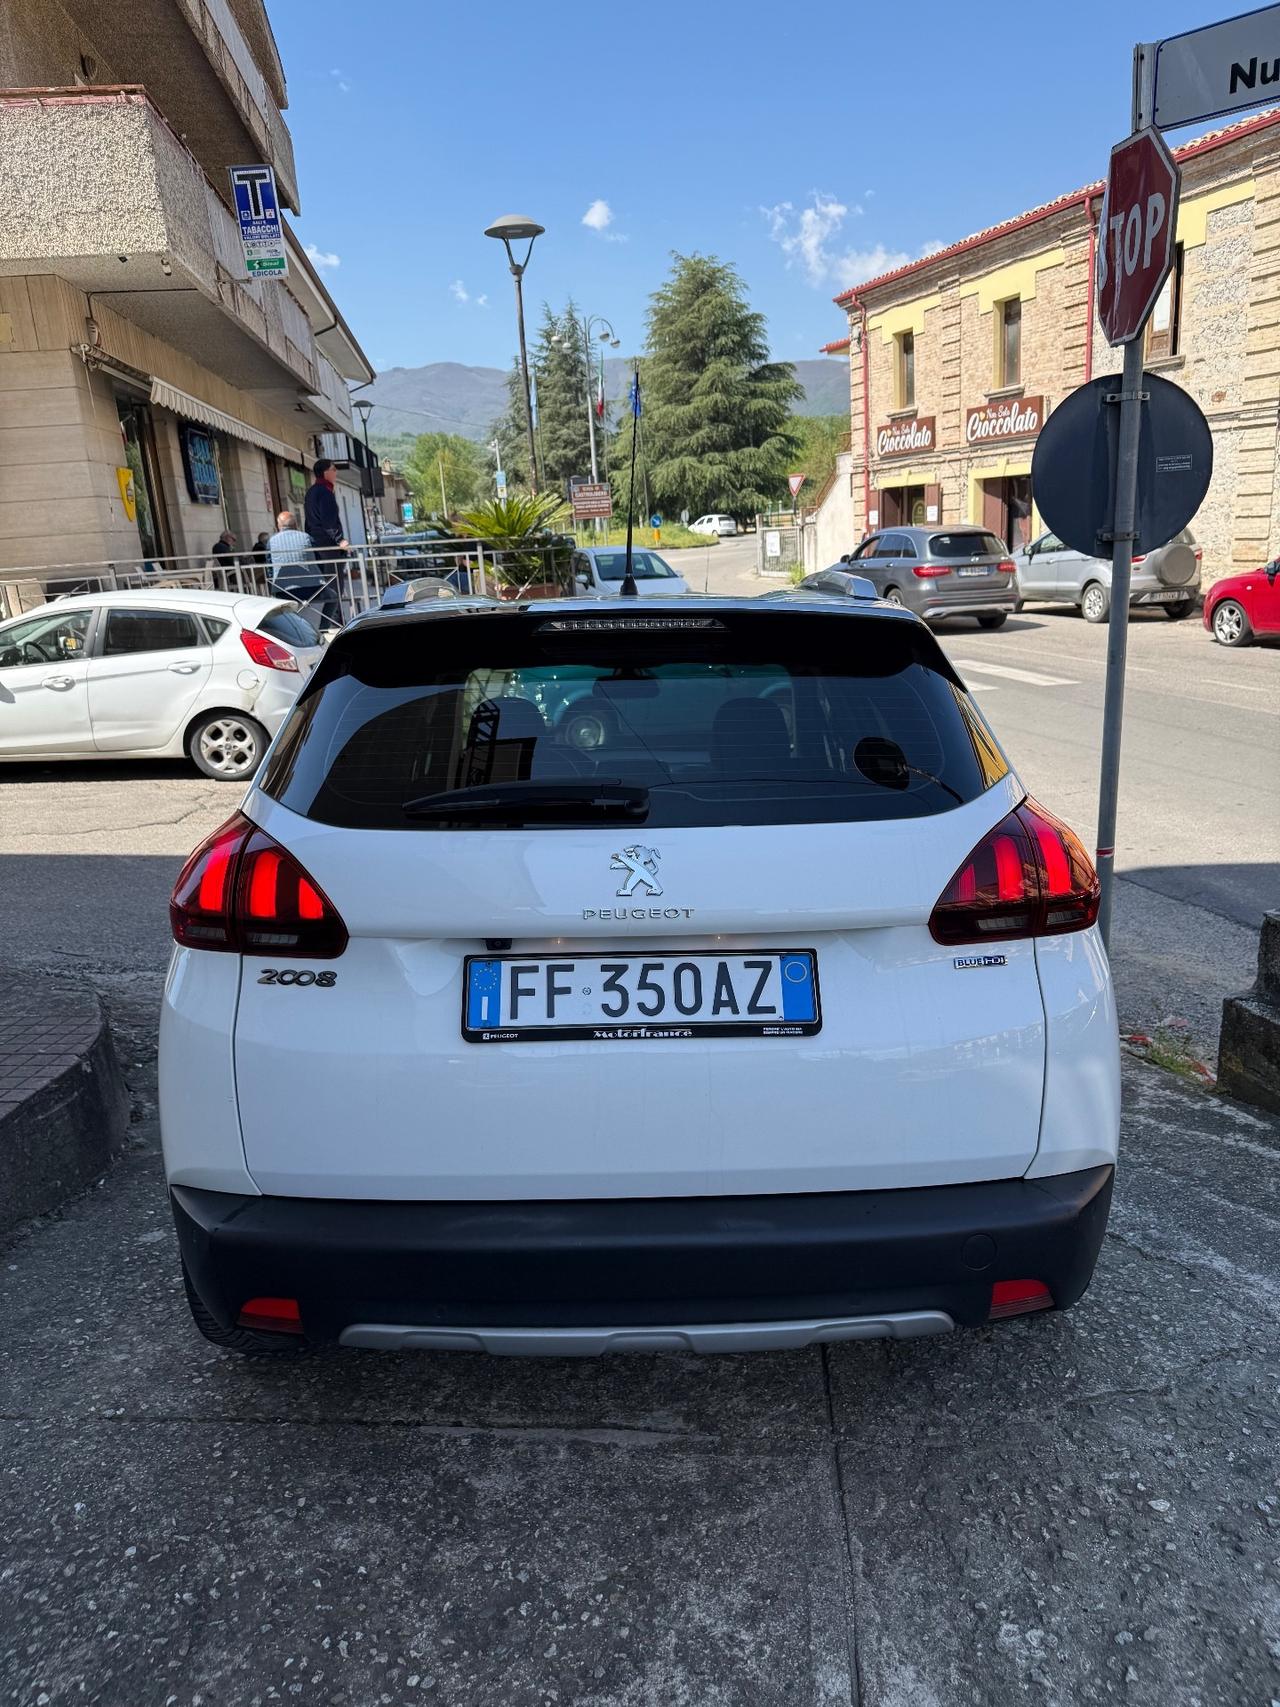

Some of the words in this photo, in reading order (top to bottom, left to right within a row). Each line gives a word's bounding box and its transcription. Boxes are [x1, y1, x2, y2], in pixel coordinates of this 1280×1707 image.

[1229, 56, 1280, 94] Nu
[242, 225, 279, 235] TABACCHI
[878, 421, 931, 455] Cioccolato
[967, 402, 1038, 441] Cioccolato
[583, 907, 695, 920] PEUGEOT
[257, 969, 337, 987] 2008
[510, 964, 575, 1019] FF
[600, 960, 776, 1017] 350AZ
